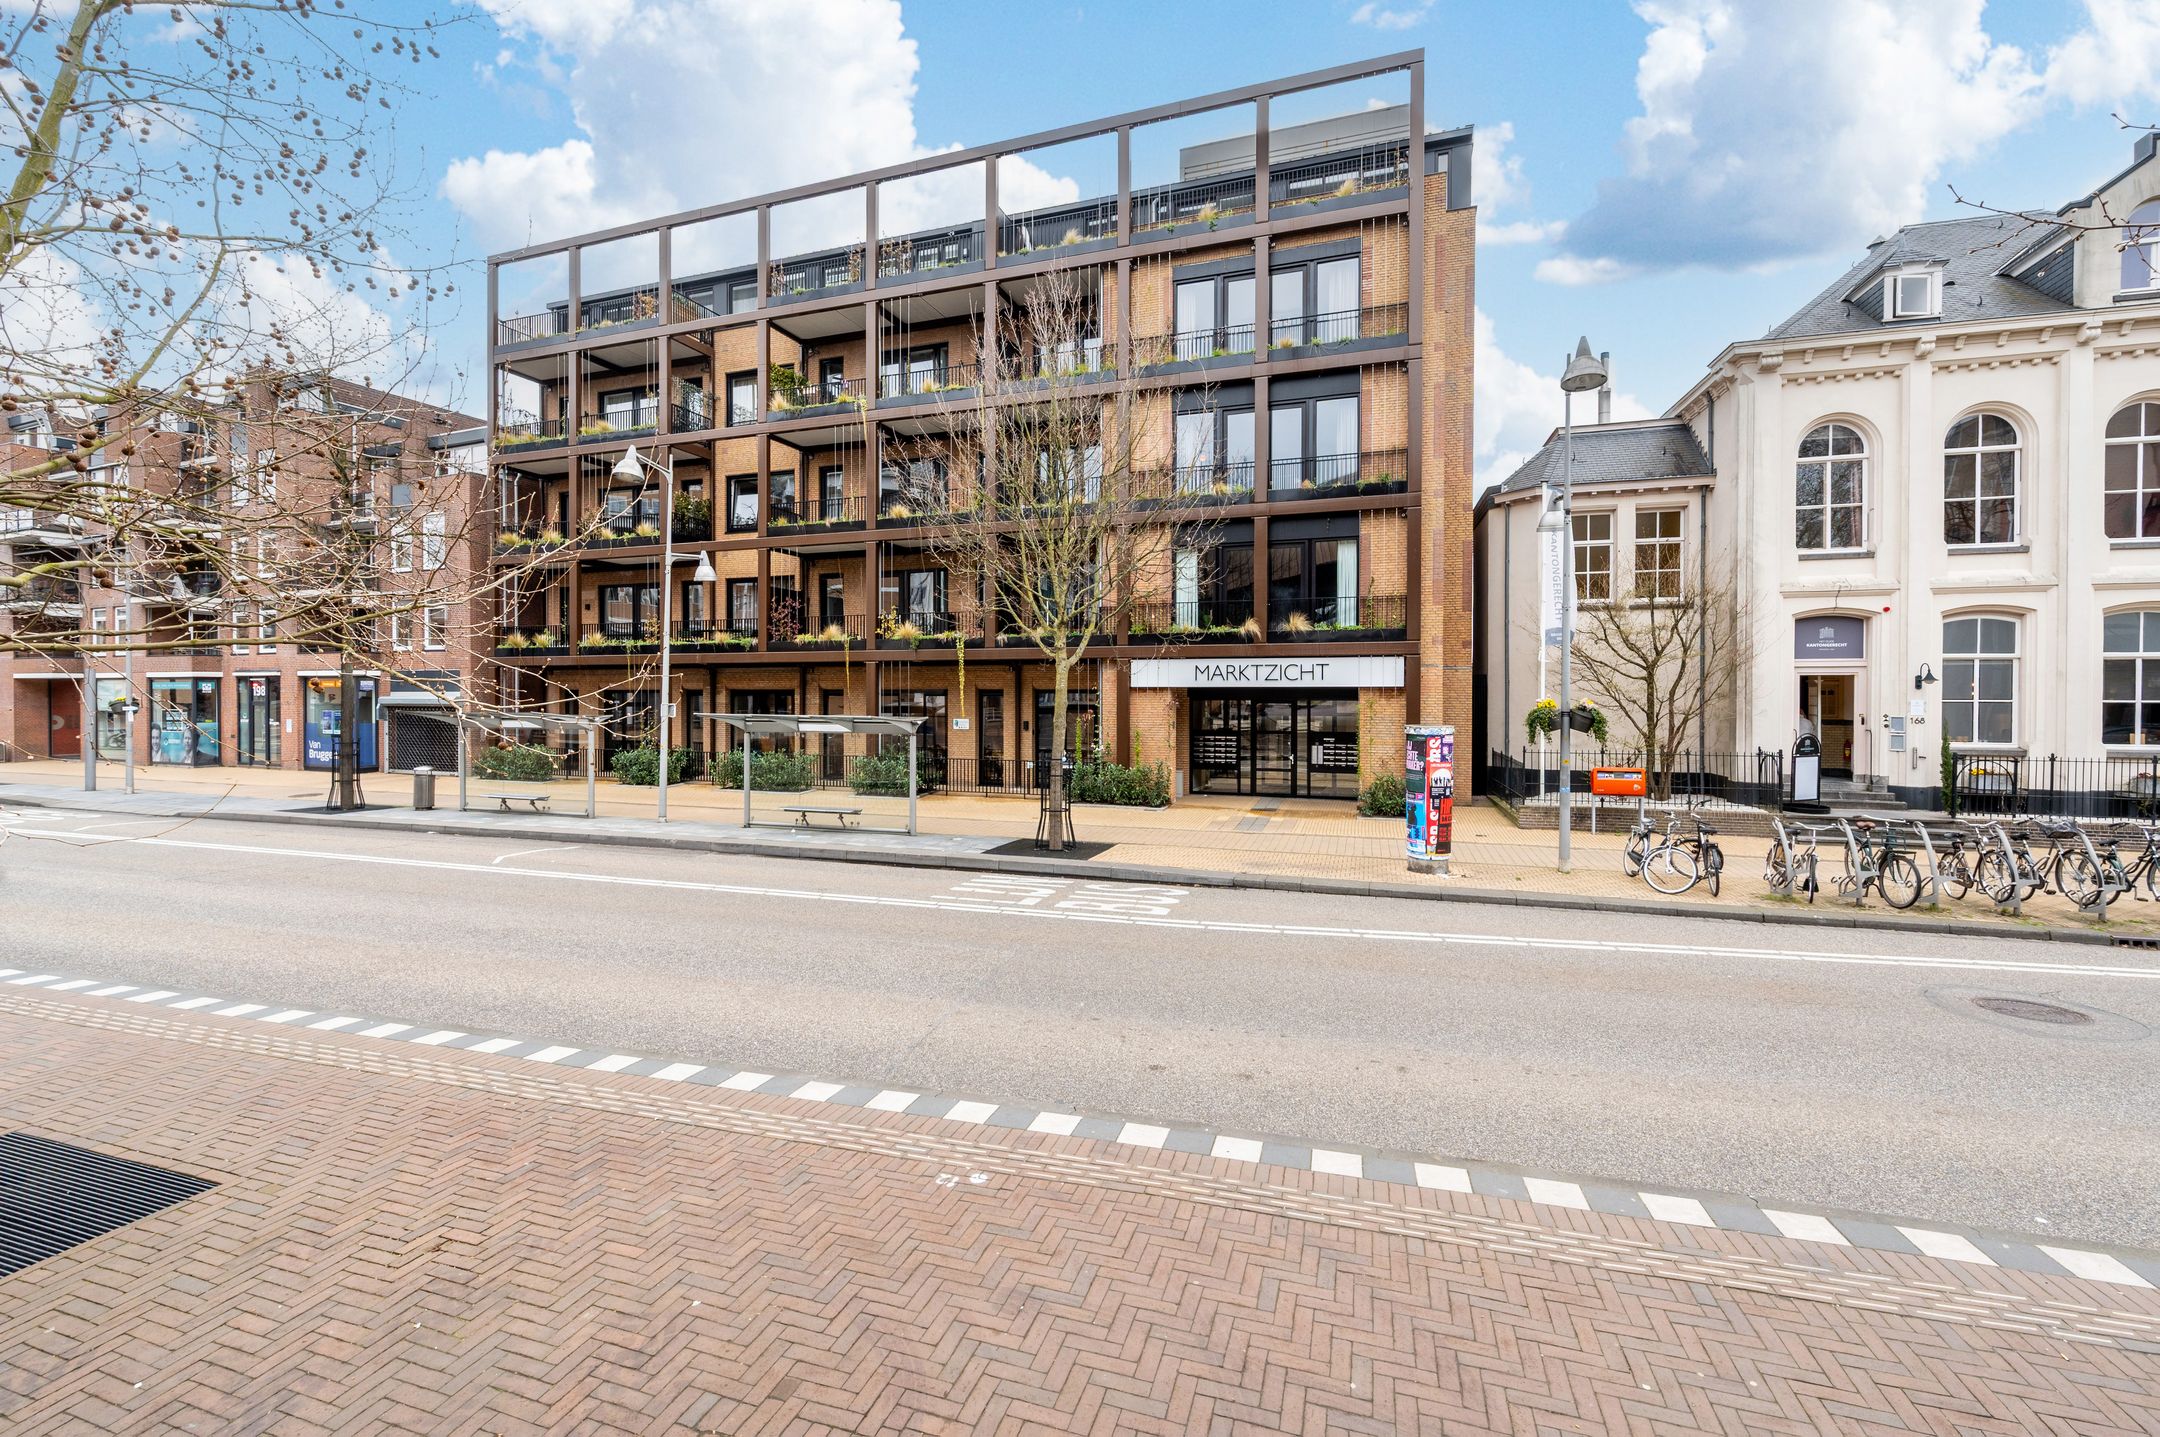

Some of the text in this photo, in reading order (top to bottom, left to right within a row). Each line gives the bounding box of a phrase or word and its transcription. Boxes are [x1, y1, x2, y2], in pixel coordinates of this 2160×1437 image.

[1194, 663, 1330, 682] MARKTZICHT
[252, 685, 266, 697] 198
[1910, 717, 1926, 725] 168
[308, 740, 321, 749] Van
[308, 749, 338, 762] Brugge
[1054, 884, 1190, 916] BUS
